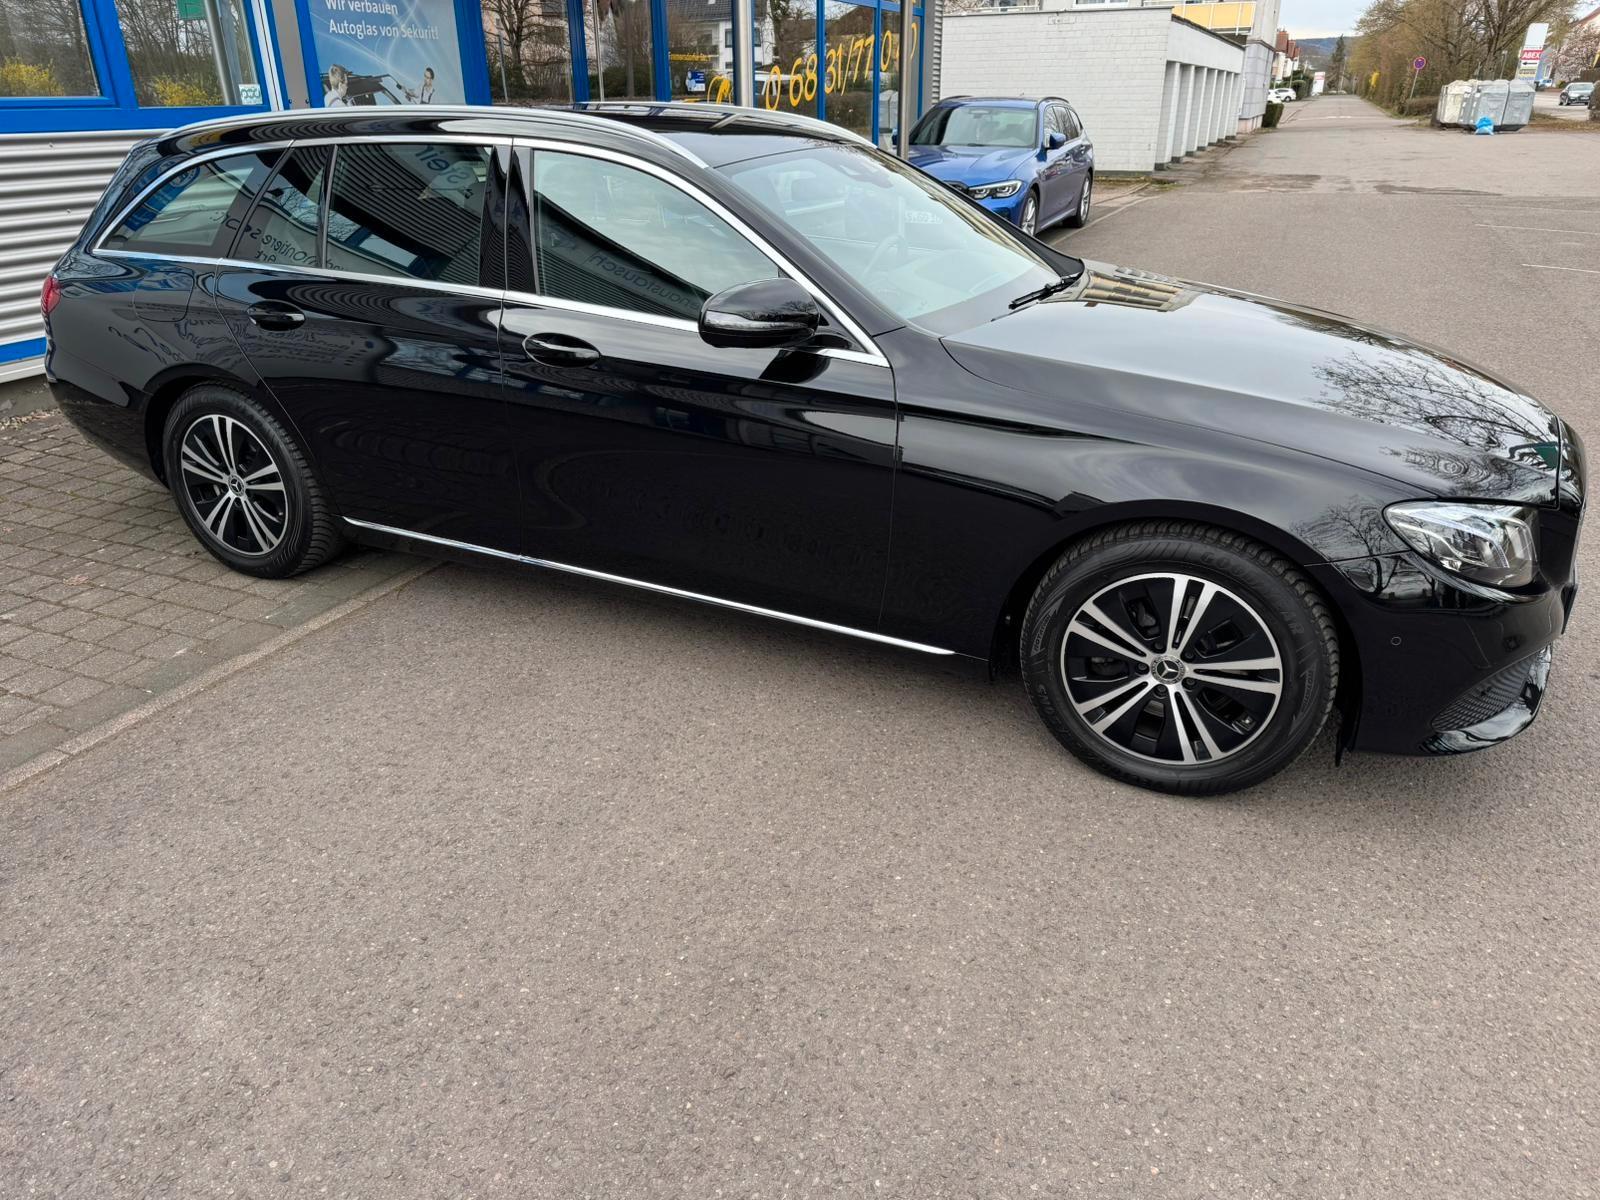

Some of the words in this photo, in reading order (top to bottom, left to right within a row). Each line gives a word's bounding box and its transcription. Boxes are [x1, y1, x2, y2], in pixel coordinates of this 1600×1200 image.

[326, 0, 347, 11] Wir
[348, 0, 399, 15] verbauen
[329, 19, 378, 39] Autoglas
[380, 25, 400, 37] von
[400, 23, 440, 40] Sekurit!
